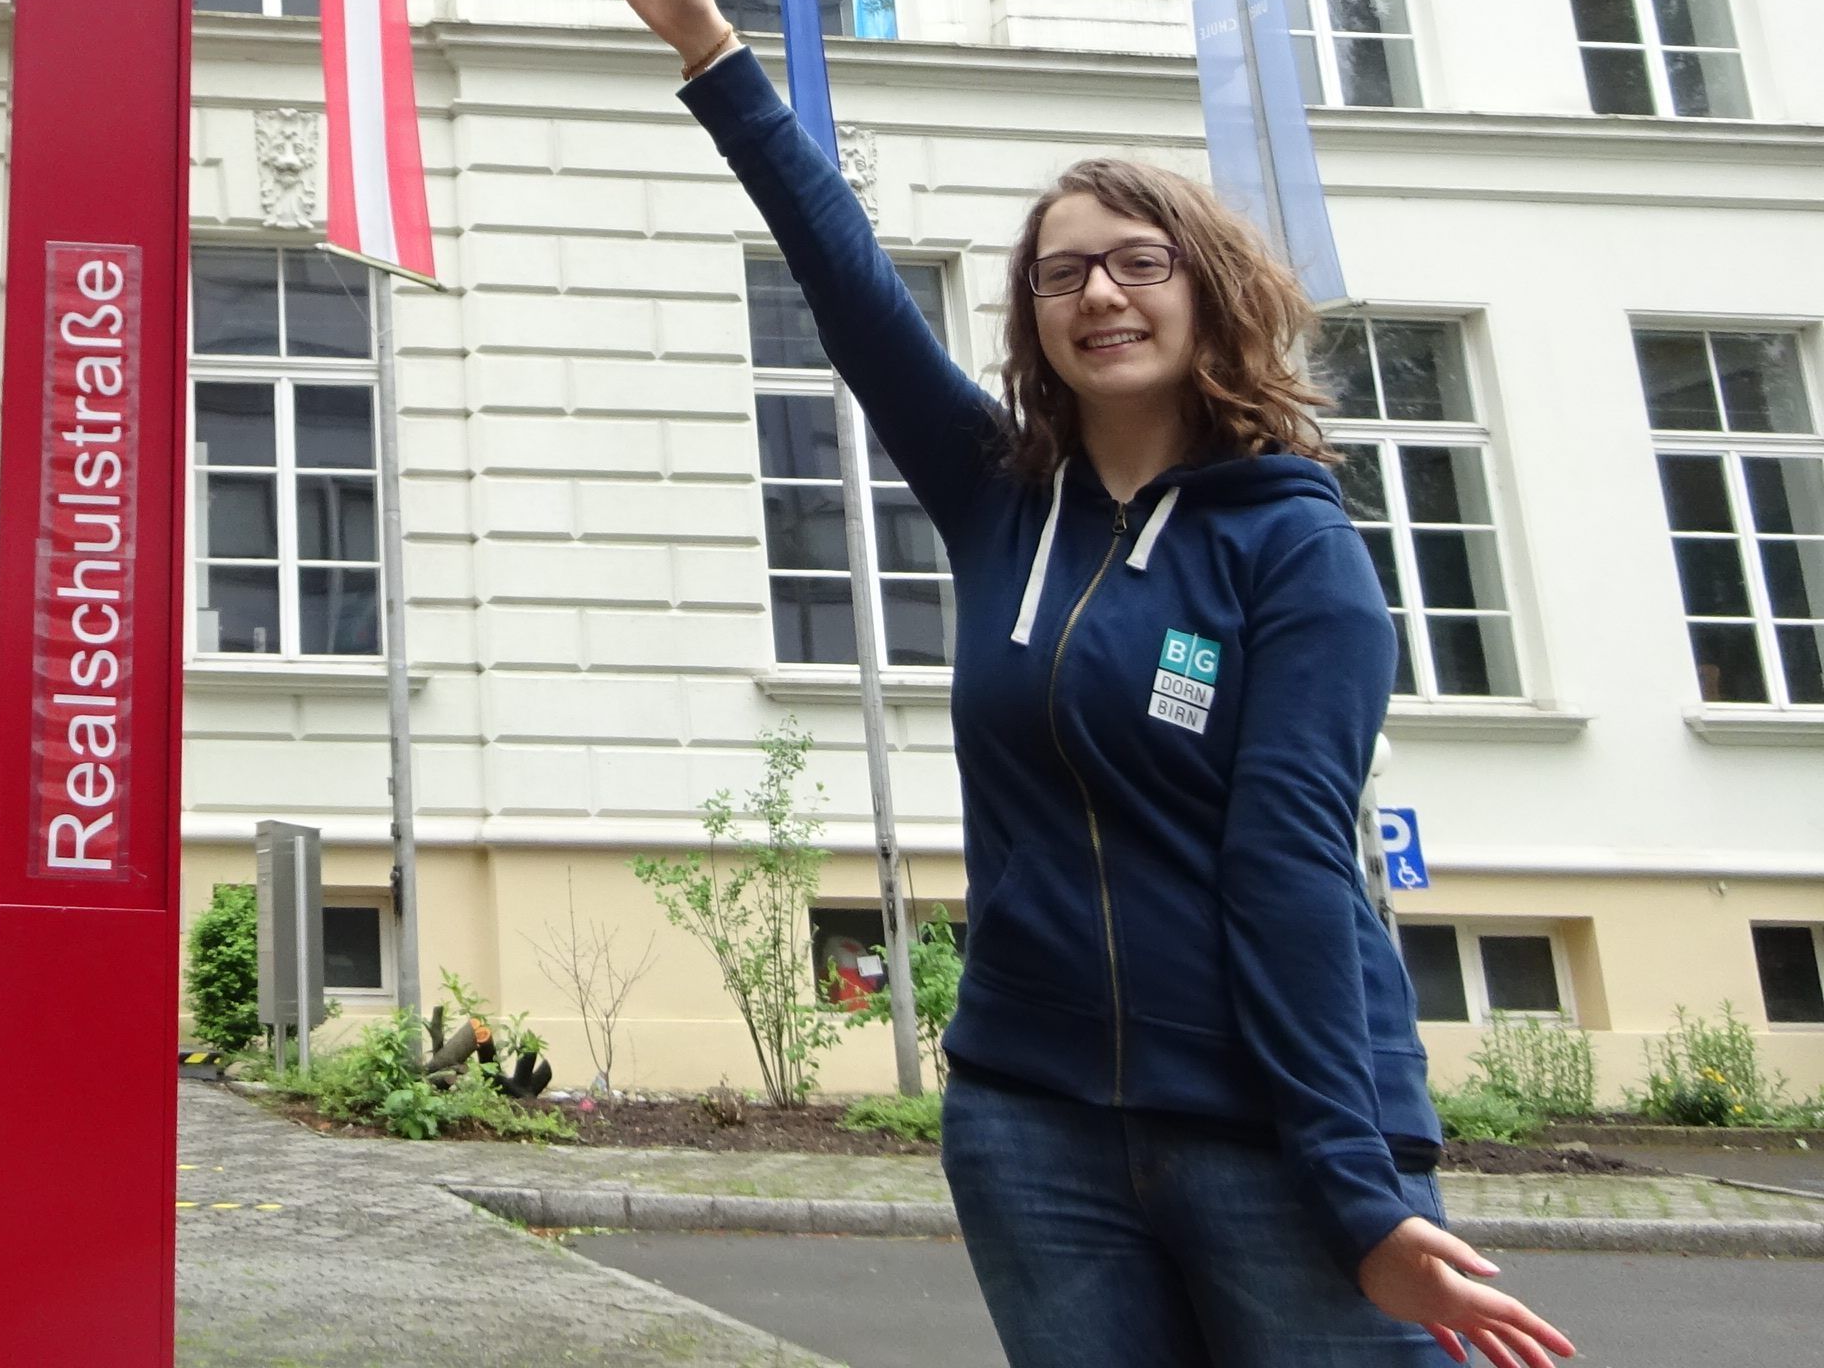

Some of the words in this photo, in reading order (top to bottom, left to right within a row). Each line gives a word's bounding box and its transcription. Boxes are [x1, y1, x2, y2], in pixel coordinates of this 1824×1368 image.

[47, 259, 123, 872] Realschulstraße
[1160, 675, 1208, 704] DORN
[1157, 699, 1199, 727] BIRN
